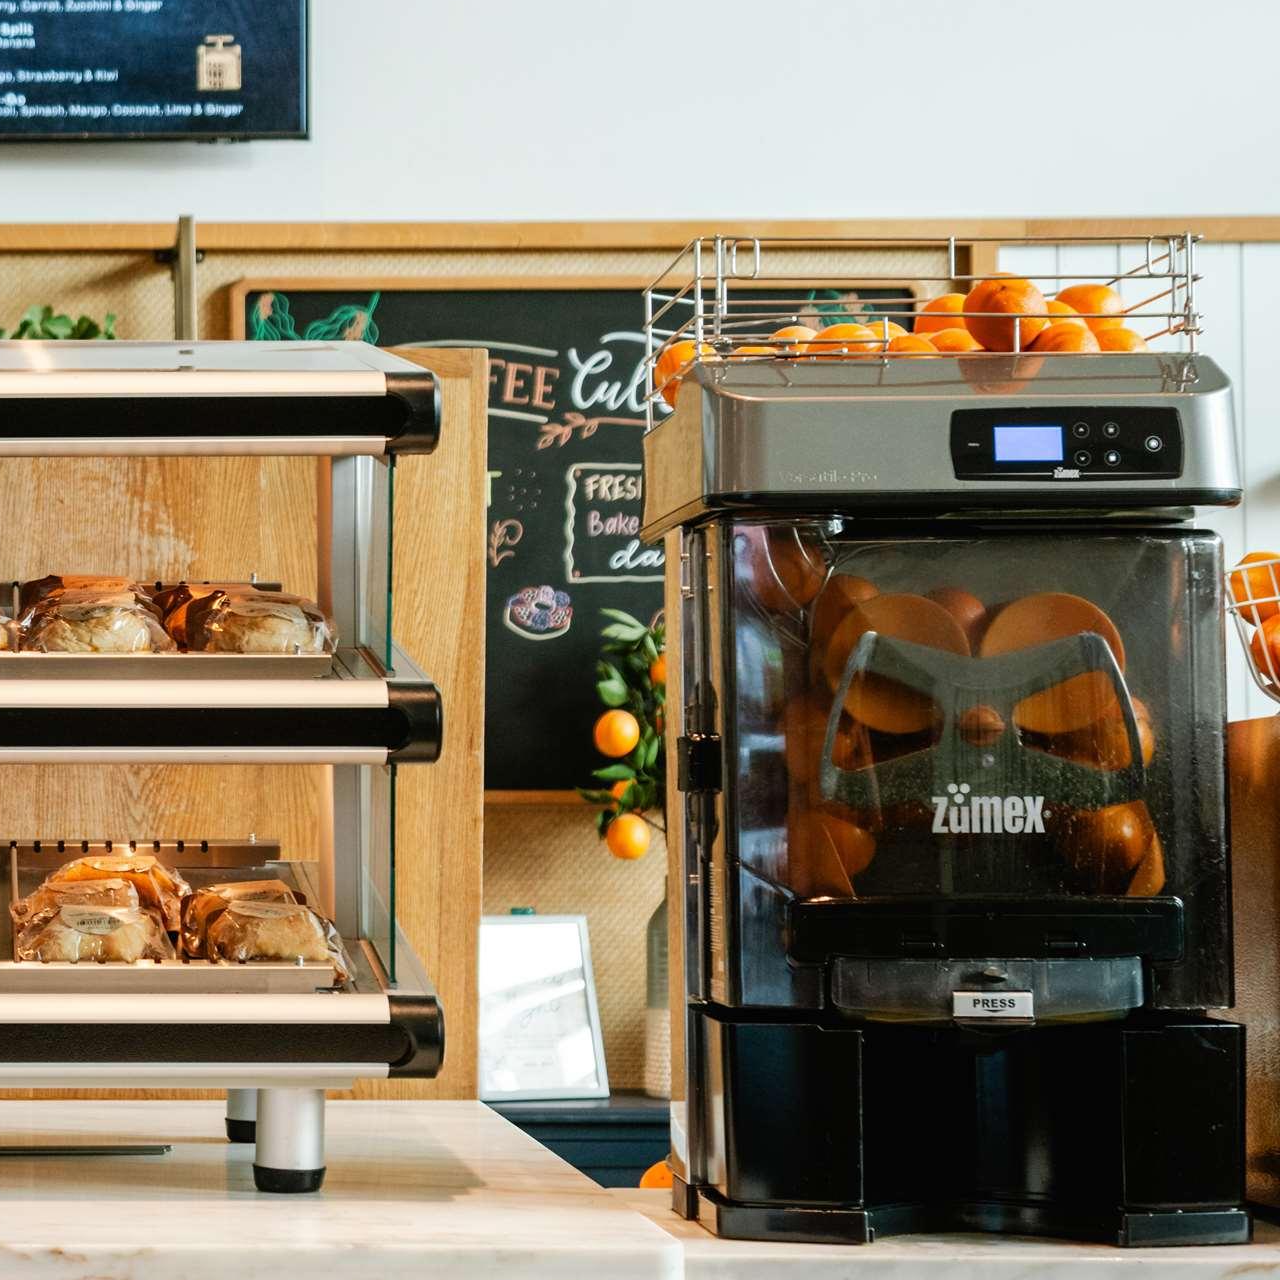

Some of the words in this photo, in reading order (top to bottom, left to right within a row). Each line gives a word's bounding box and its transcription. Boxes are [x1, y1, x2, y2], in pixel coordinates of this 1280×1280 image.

[488, 359, 560, 410] FEE
[585, 474, 641, 501] FRES
[587, 510, 639, 537] Bake
[973, 999, 1016, 1008] PRESS
